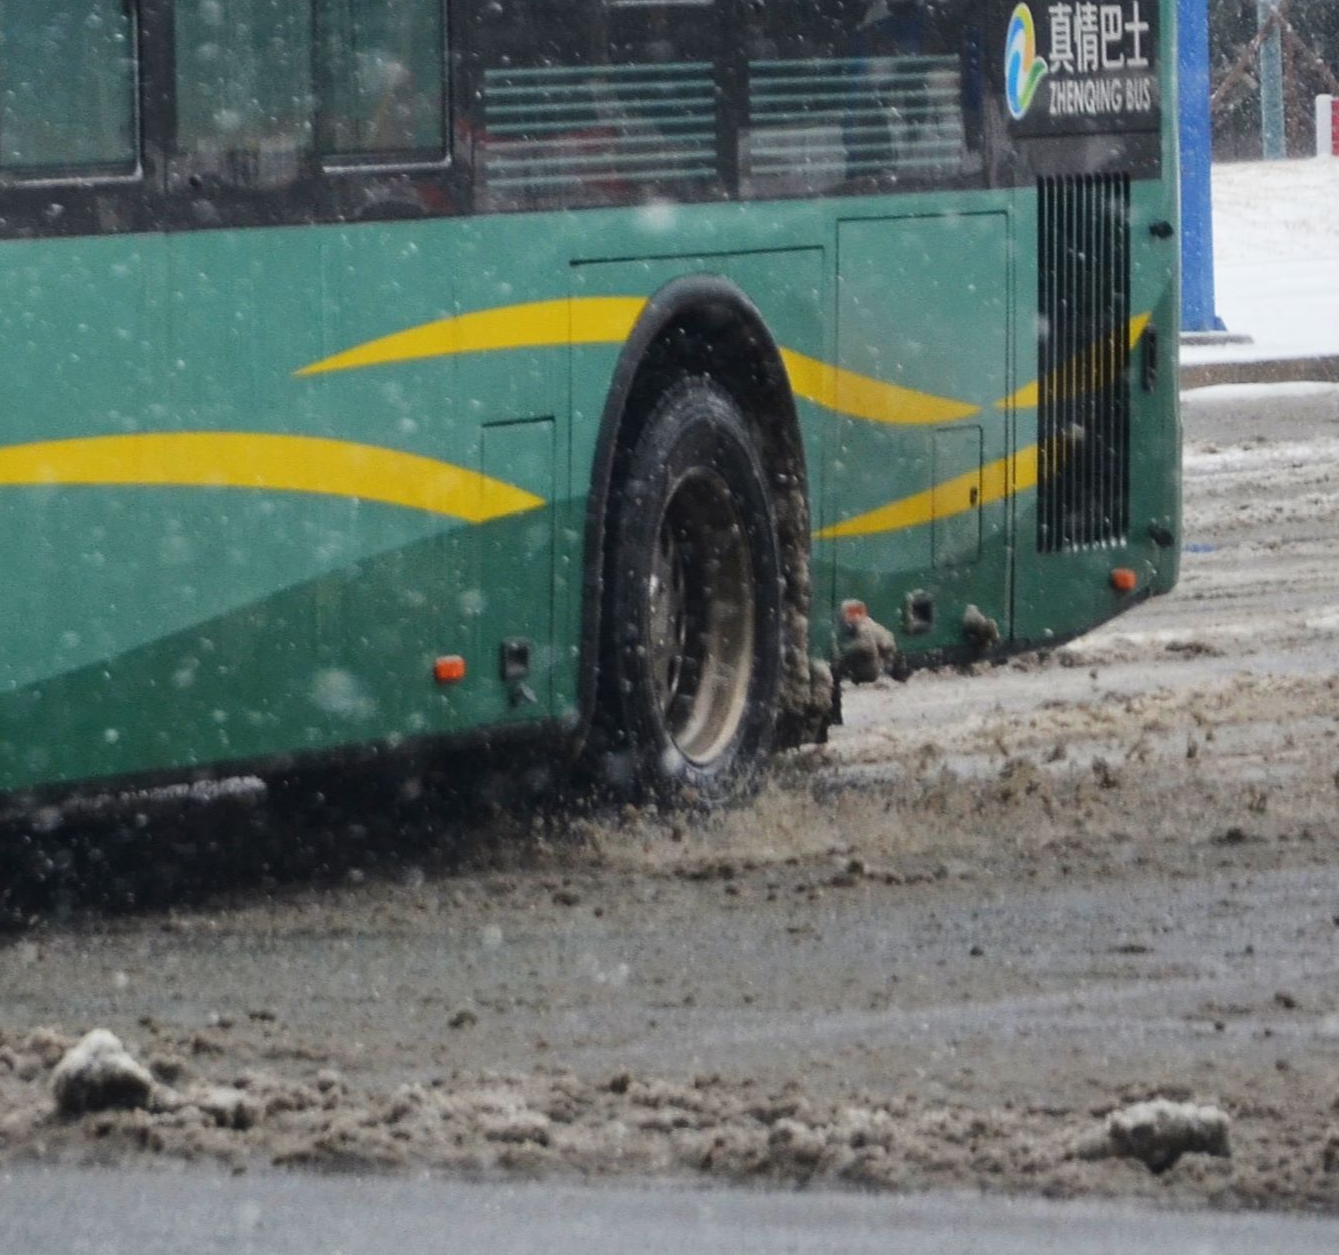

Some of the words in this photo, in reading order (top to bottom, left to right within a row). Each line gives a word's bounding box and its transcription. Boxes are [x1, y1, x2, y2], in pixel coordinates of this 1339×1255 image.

[1047, 0, 1150, 73] 真情巴士
[1048, 77, 1123, 116] ZHENQING
[1124, 77, 1151, 112] BUS
